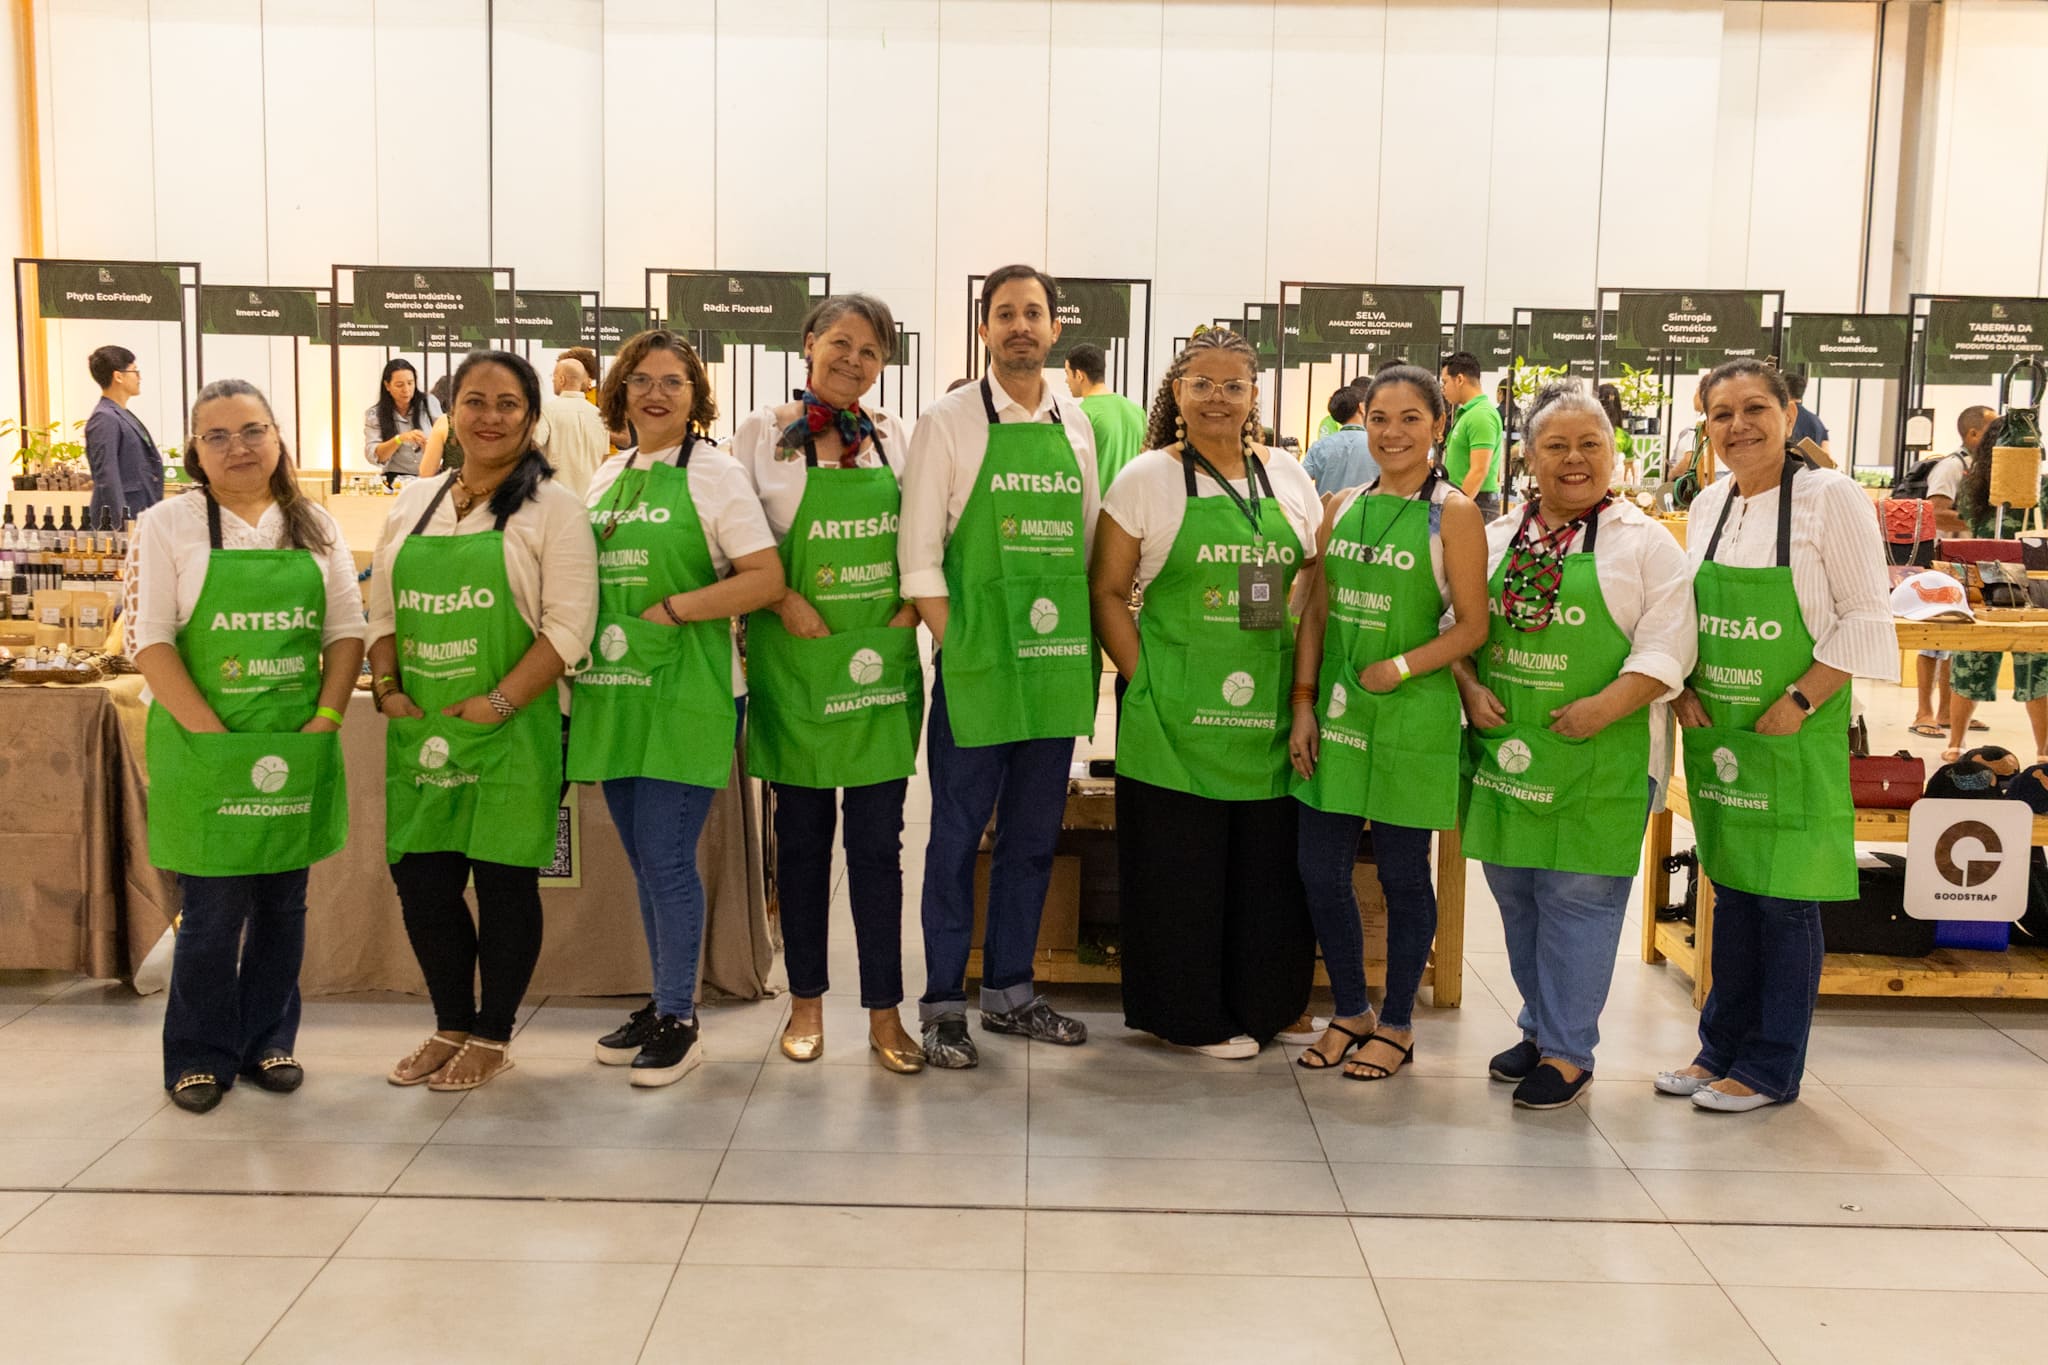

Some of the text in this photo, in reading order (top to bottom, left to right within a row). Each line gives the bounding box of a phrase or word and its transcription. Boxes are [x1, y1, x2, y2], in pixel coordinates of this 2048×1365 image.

[66, 291, 152, 304] Phyto EcoFriendly
[386, 292, 417, 300] Plantus
[418, 291, 455, 301] Indústria
[384, 301, 422, 310] comércio
[423, 302, 434, 310] de
[435, 301, 457, 310] óleos
[731, 304, 773, 314] Florestal
[1056, 304, 1080, 313] oaria
[261, 309, 280, 318] Café
[403, 311, 445, 319] saneantes
[1355, 311, 1387, 320] SELVA
[1668, 312, 1712, 323] Sintropia
[1328, 320, 1412, 329] AMAZONIC BLOCKCHAIN
[1662, 323, 1717, 333] Cosméticos
[1969, 323, 2033, 333] TABERNA DA
[1349, 328, 1391, 336] ECOSYSTEM
[1553, 332, 1584, 341] Magnus
[1668, 334, 1710, 344] Naturais
[1972, 333, 2028, 344] AMAZÔNIA
[990, 472, 1082, 494] ARTESÃO
[808, 511, 899, 540] ARTESÃO
[1021, 520, 1075, 537] AMAZONAS
[600, 549, 649, 567] AMAZONAS
[1196, 541, 1296, 565] ARTESÃO
[840, 561, 893, 583] AMAZONAS
[398, 585, 495, 615] ARTESÃO
[1337, 587, 1392, 611] AMAZONAS
[417, 638, 478, 660] AMAZONAS
[1018, 644, 1088, 659] AMAZONENSE
[248, 656, 305, 676] AMAZONAS
[1507, 648, 1568, 671] AMAZONAS
[575, 673, 653, 687] AMAZONENSE
[1705, 664, 1763, 686] AMAZONAS
[824, 691, 908, 715] AMAZONENSE
[1192, 715, 1277, 730] AMAZONENSE
[1472, 774, 1554, 803] AMAZONENSE
[217, 802, 311, 817] AMAZONENSE
[1934, 892, 1998, 902] GOODSTRAP
